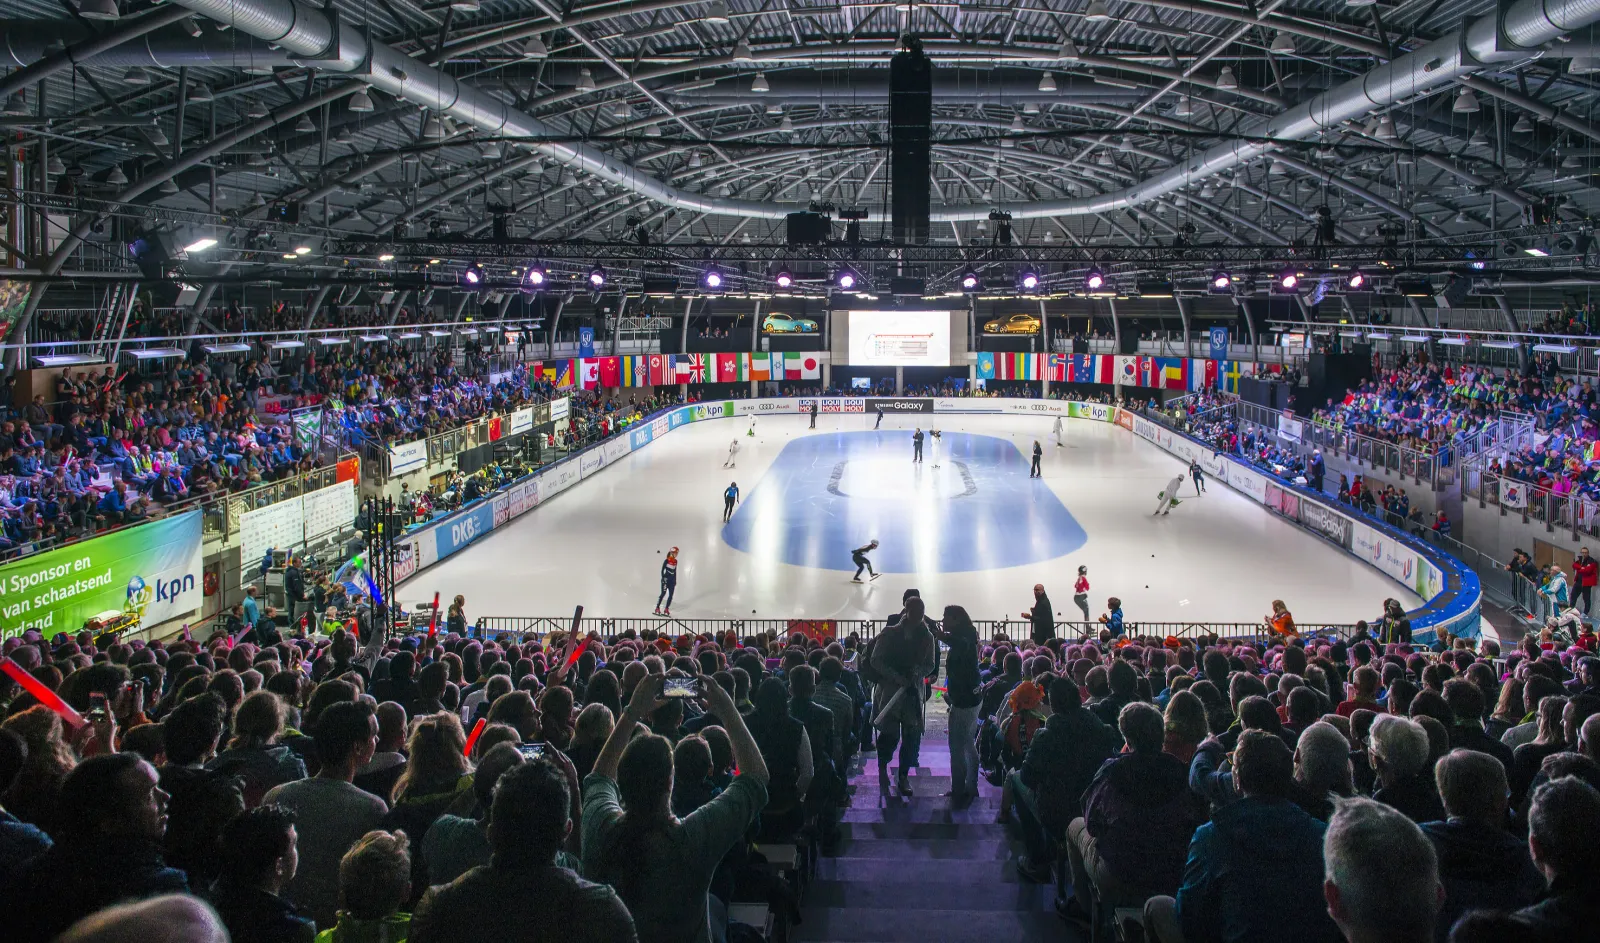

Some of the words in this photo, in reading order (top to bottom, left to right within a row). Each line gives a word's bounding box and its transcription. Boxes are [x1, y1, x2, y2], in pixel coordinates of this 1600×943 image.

[707, 405, 723, 416] kpn
[894, 401, 923, 411] Galaxy
[1092, 406, 1108, 418] kpn
[452, 518, 474, 546] DKB
[11, 562, 72, 593] Sponsor
[74, 556, 91, 571] en
[395, 558, 414, 580] MOLY
[3, 600, 31, 619] van
[34, 568, 112, 608] schaatsend
[156, 573, 194, 603] kpn
